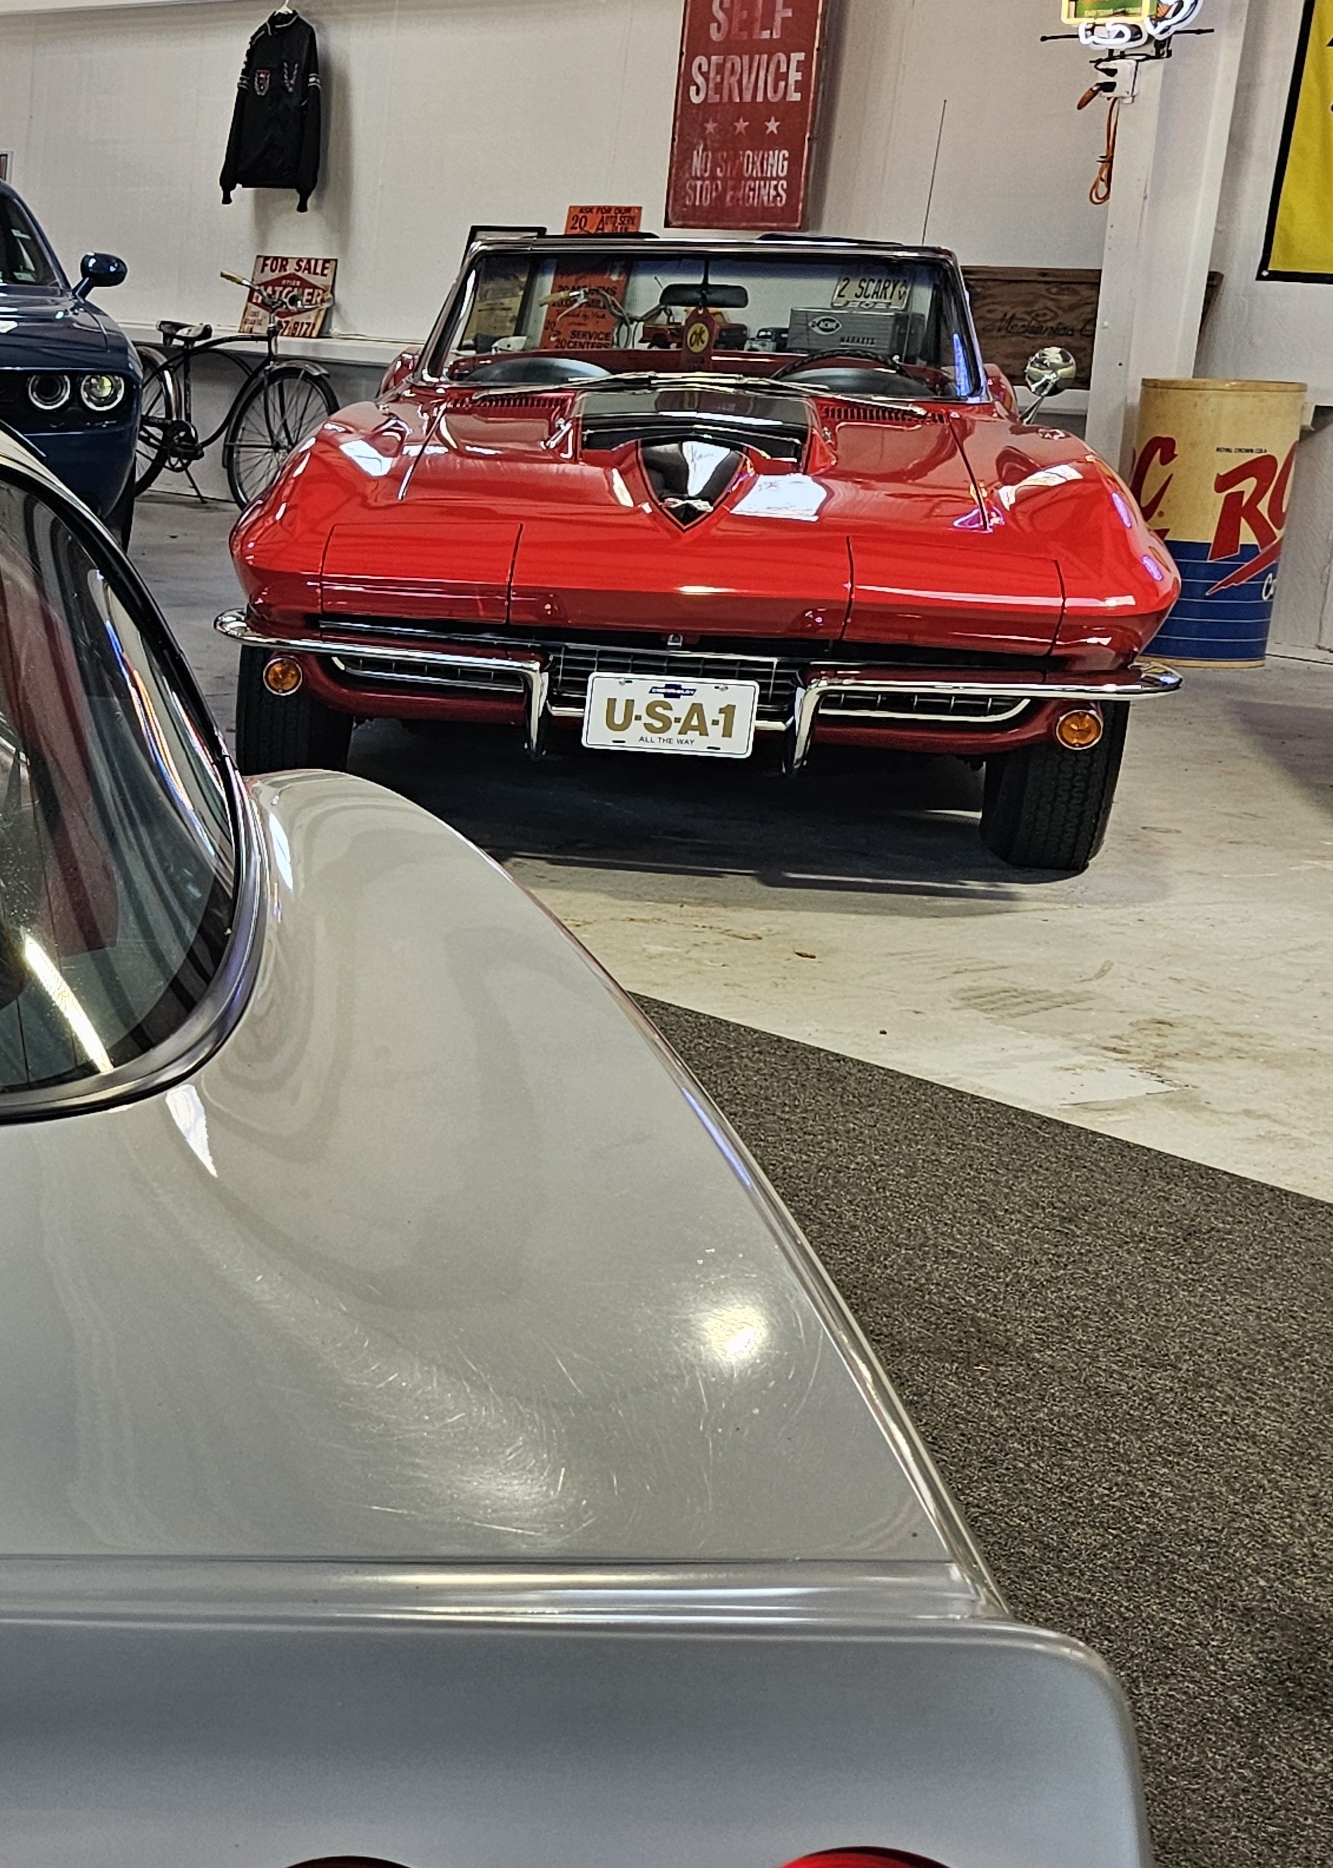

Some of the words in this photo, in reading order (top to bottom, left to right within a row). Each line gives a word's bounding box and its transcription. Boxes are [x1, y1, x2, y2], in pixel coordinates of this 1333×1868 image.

[689, 52, 806, 104] SERVICE
[691, 149, 711, 177] NO
[260, 257, 289, 273] FOR
[294, 258, 331, 277] SALE
[638, 735, 655, 744] ALL
[657, 736, 673, 744] THE
[676, 737, 695, 746] WAY
